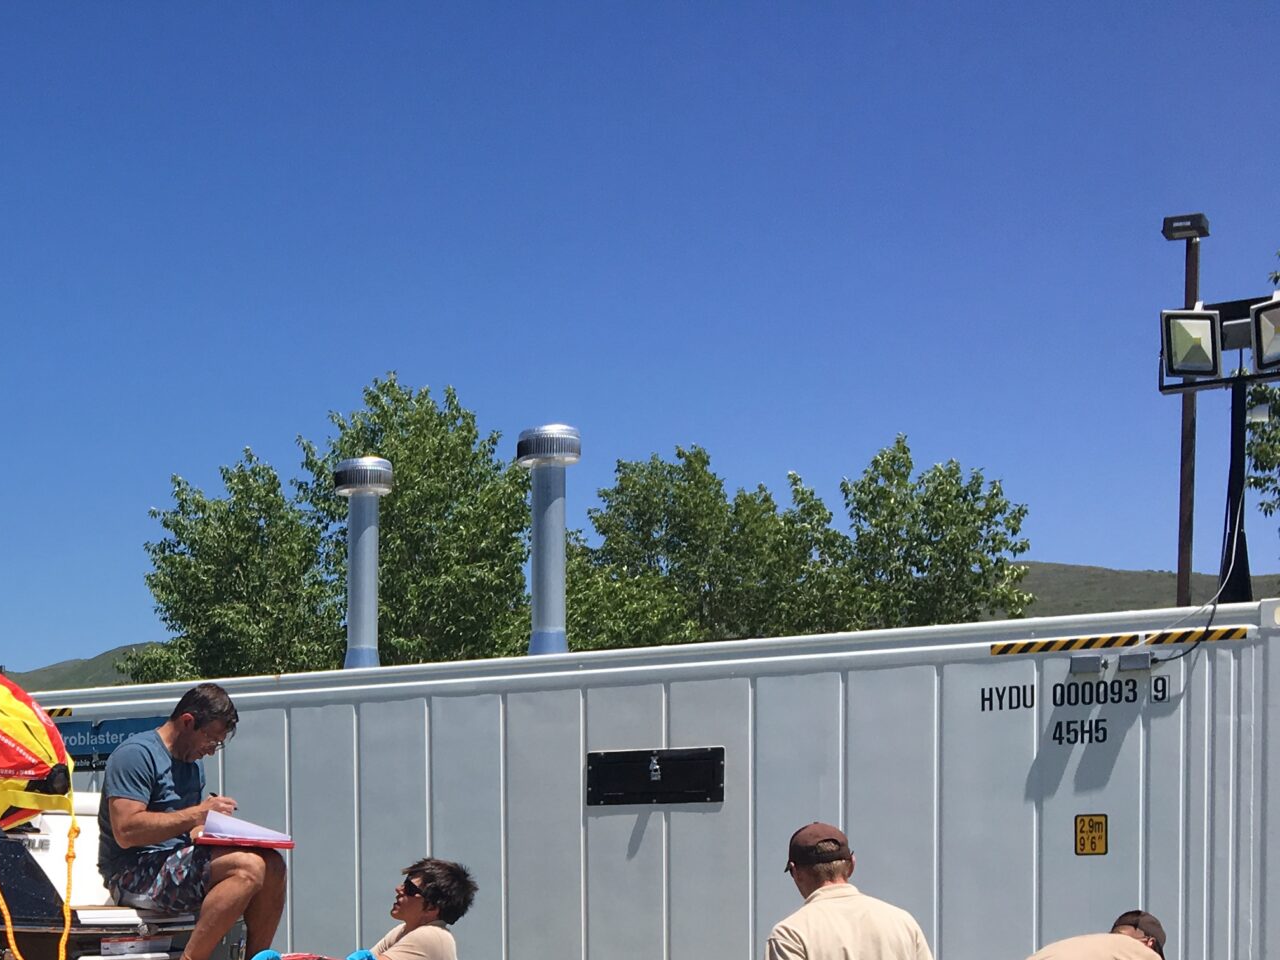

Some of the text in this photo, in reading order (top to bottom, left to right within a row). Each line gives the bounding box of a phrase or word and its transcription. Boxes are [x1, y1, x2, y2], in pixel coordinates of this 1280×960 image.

[980, 676, 1168, 711] HYDU 000093 9
[1052, 719, 1108, 745] 45H5
[1079, 817, 1104, 835] 2.9m
